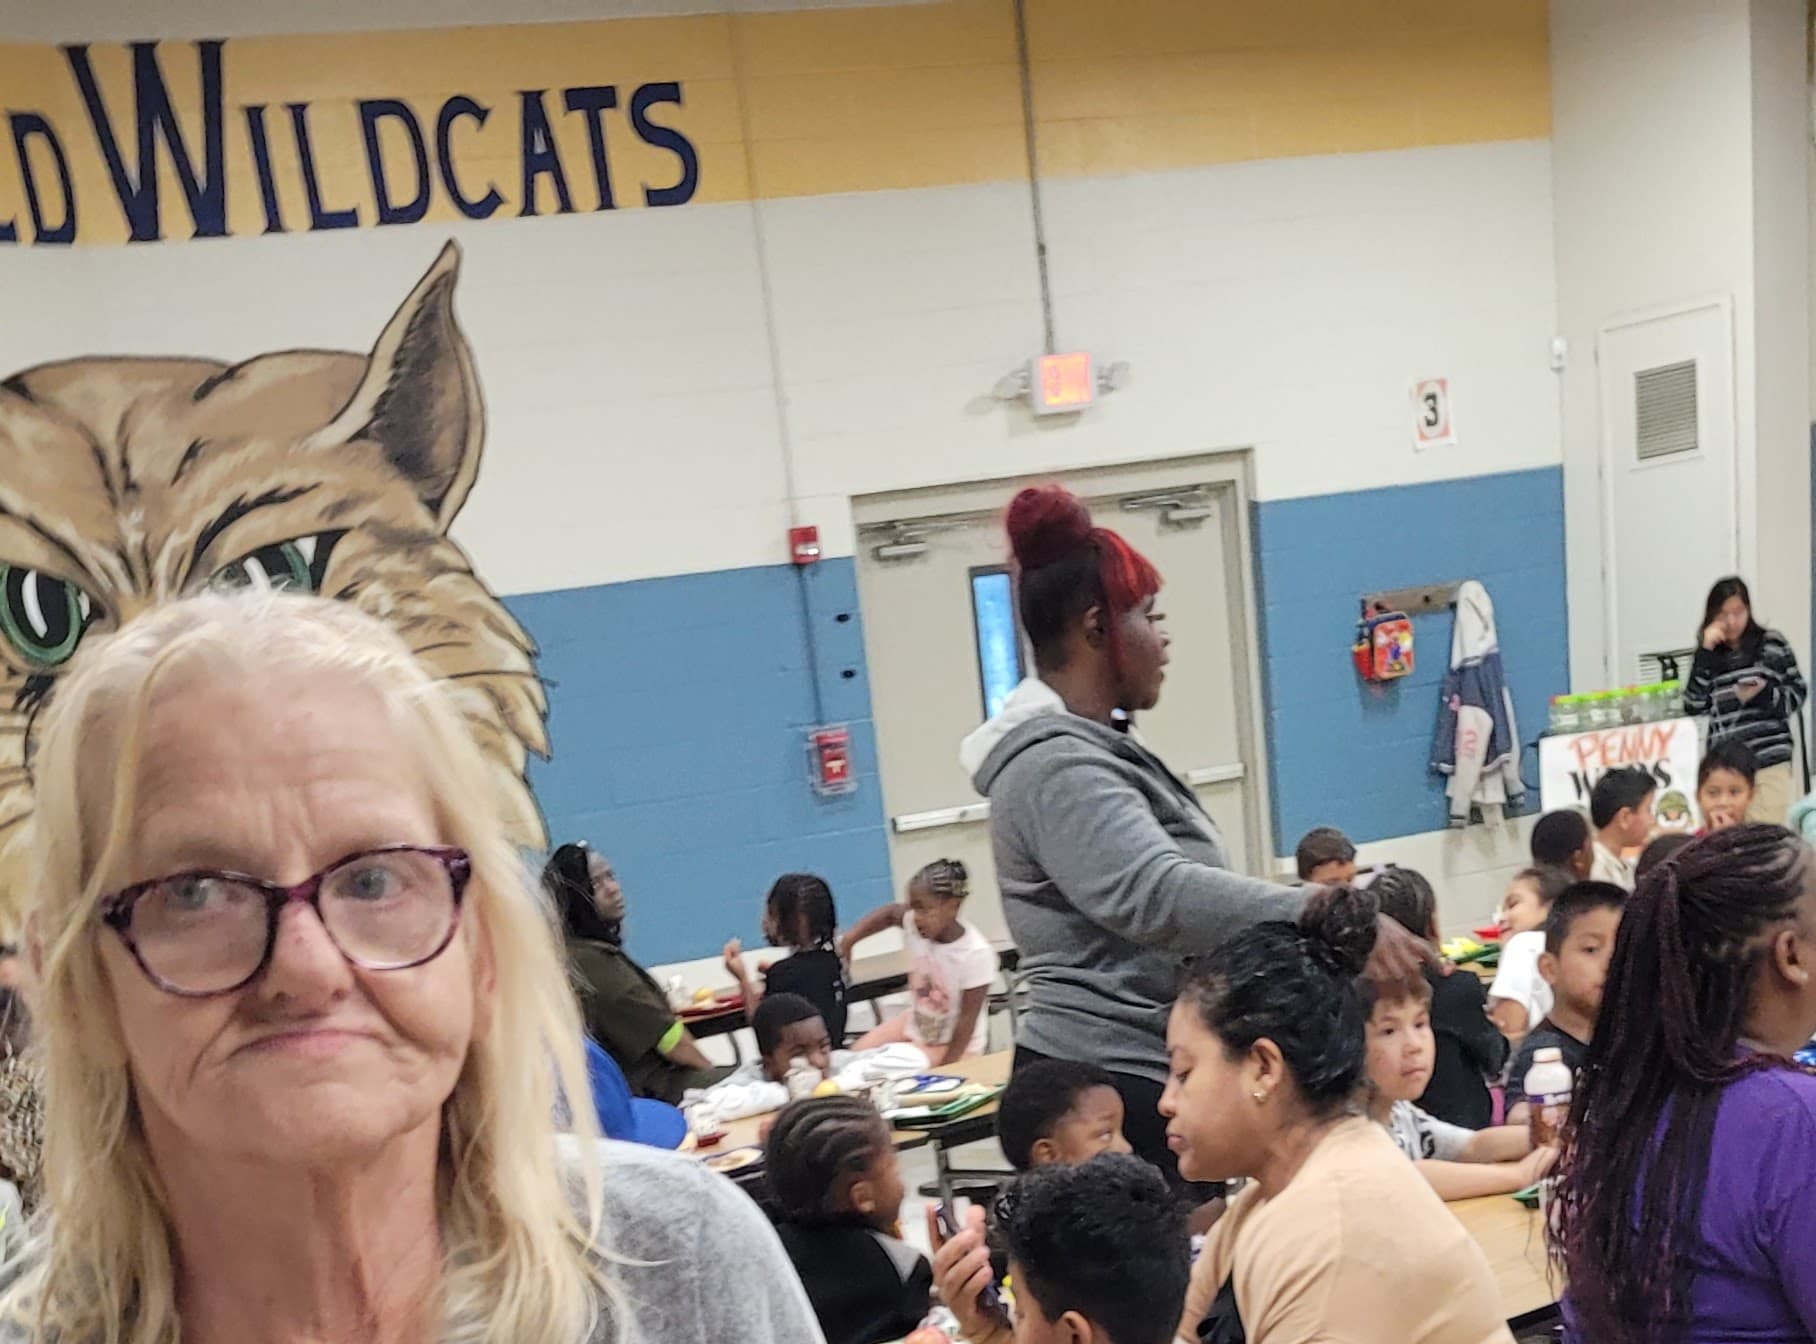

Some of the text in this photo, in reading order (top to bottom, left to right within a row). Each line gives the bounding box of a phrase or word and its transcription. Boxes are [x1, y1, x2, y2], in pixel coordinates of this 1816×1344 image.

[58, 38, 700, 242] WILDCATS
[1423, 391, 1439, 427] 3
[1568, 722, 1677, 769] PENNY
[1568, 757, 1672, 801] WS
